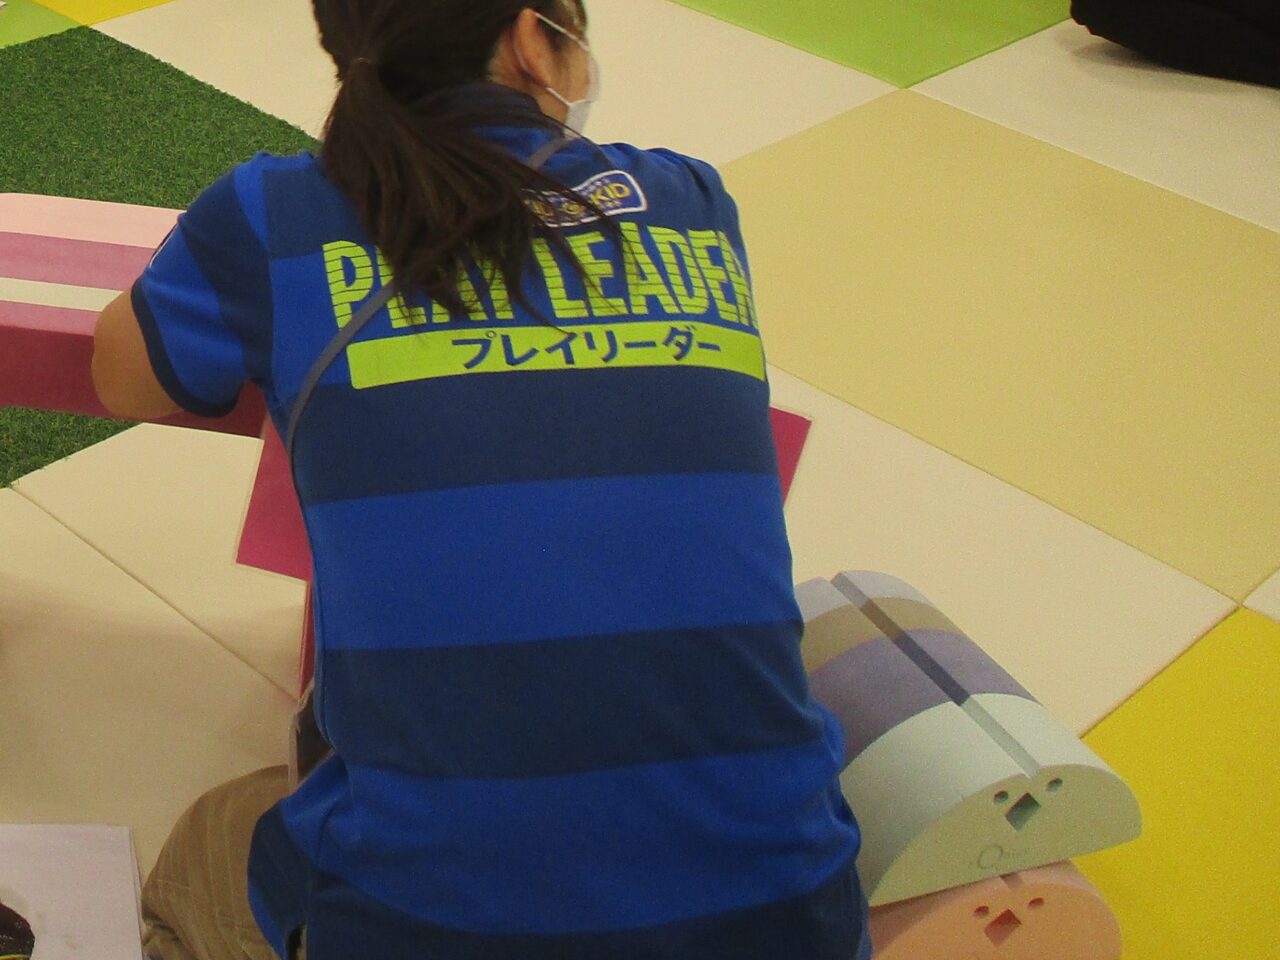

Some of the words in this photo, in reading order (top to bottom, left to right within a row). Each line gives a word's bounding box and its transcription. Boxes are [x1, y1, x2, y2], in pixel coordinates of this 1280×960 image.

[531, 222, 760, 330] LEADER
[451, 326, 721, 370] プレイリーダー
